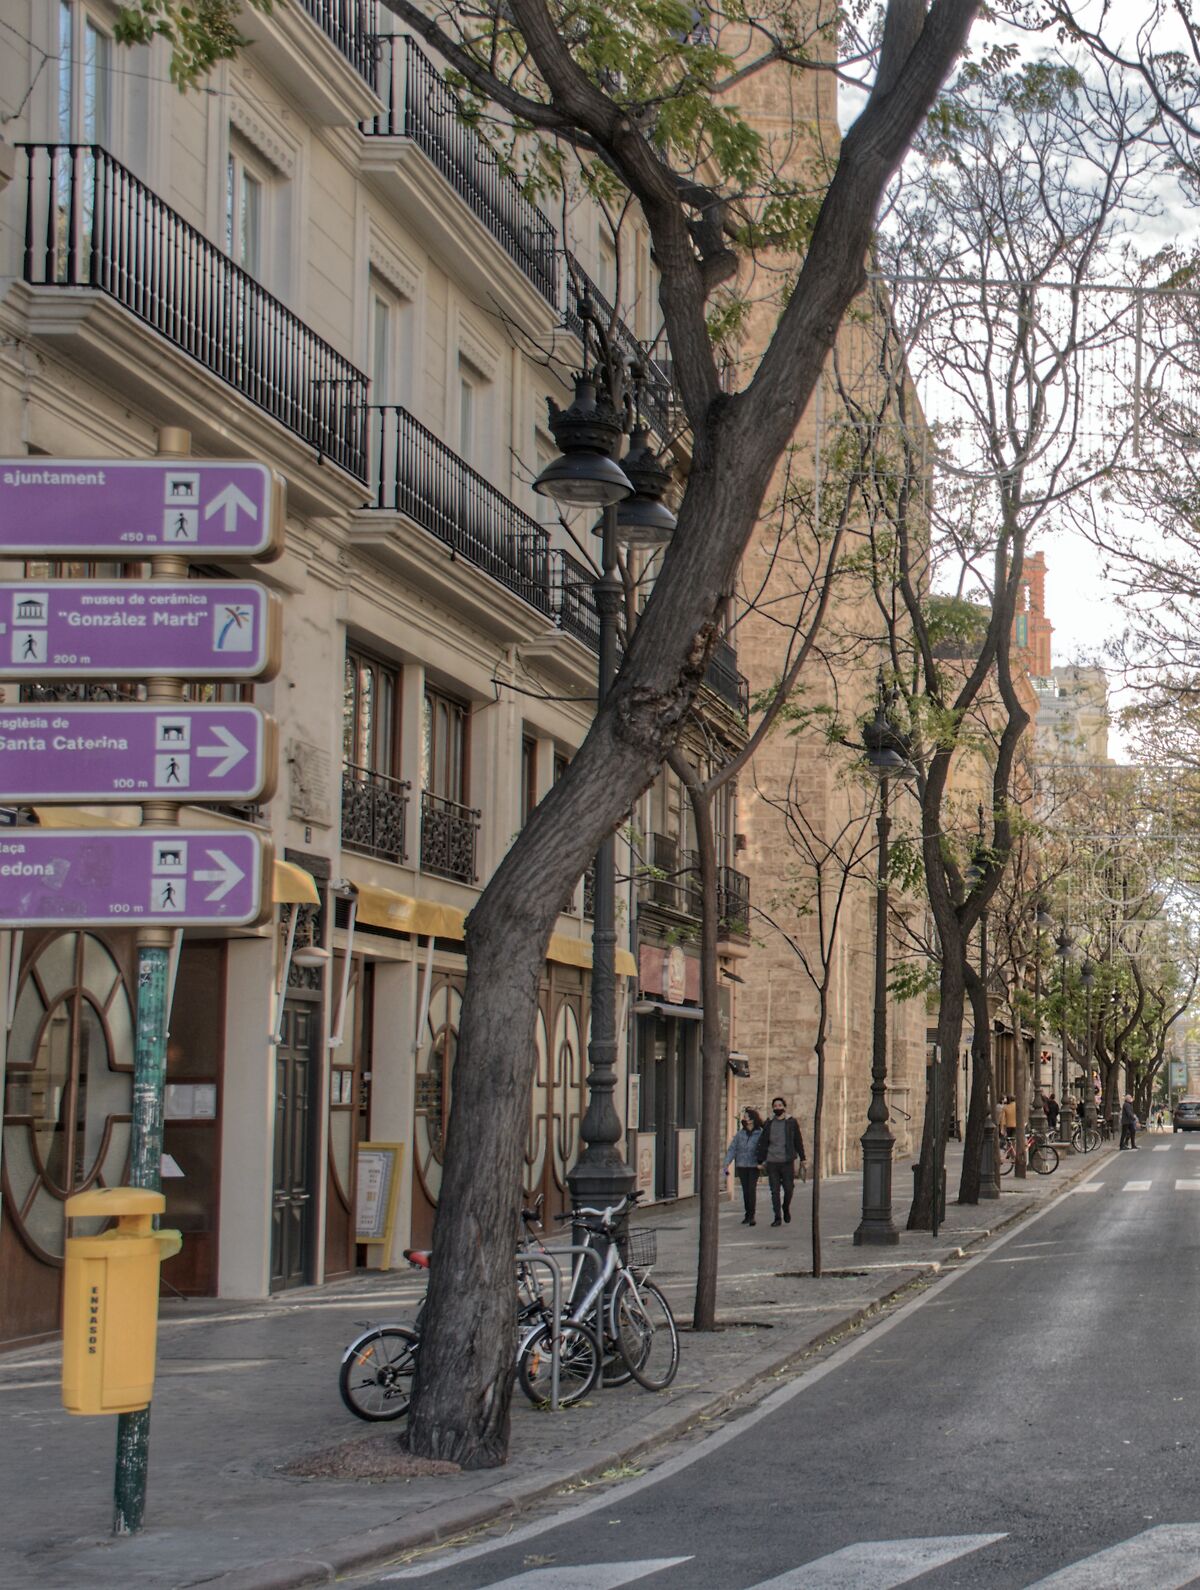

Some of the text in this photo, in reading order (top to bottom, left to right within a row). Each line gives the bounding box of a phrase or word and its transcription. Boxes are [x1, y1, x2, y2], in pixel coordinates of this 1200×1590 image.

[3, 469, 107, 487] ajuntament
[119, 531, 158, 542] 450 m
[80, 595, 125, 605] museu
[127, 593, 146, 605] de
[53, 653, 91, 664] 200 m
[51, 716, 70, 729] de
[52, 735, 129, 751] Caterina
[113, 778, 149, 789] 100 m
[108, 903, 144, 913] 100 m
[88, 1286, 99, 1355] ENVASOS
